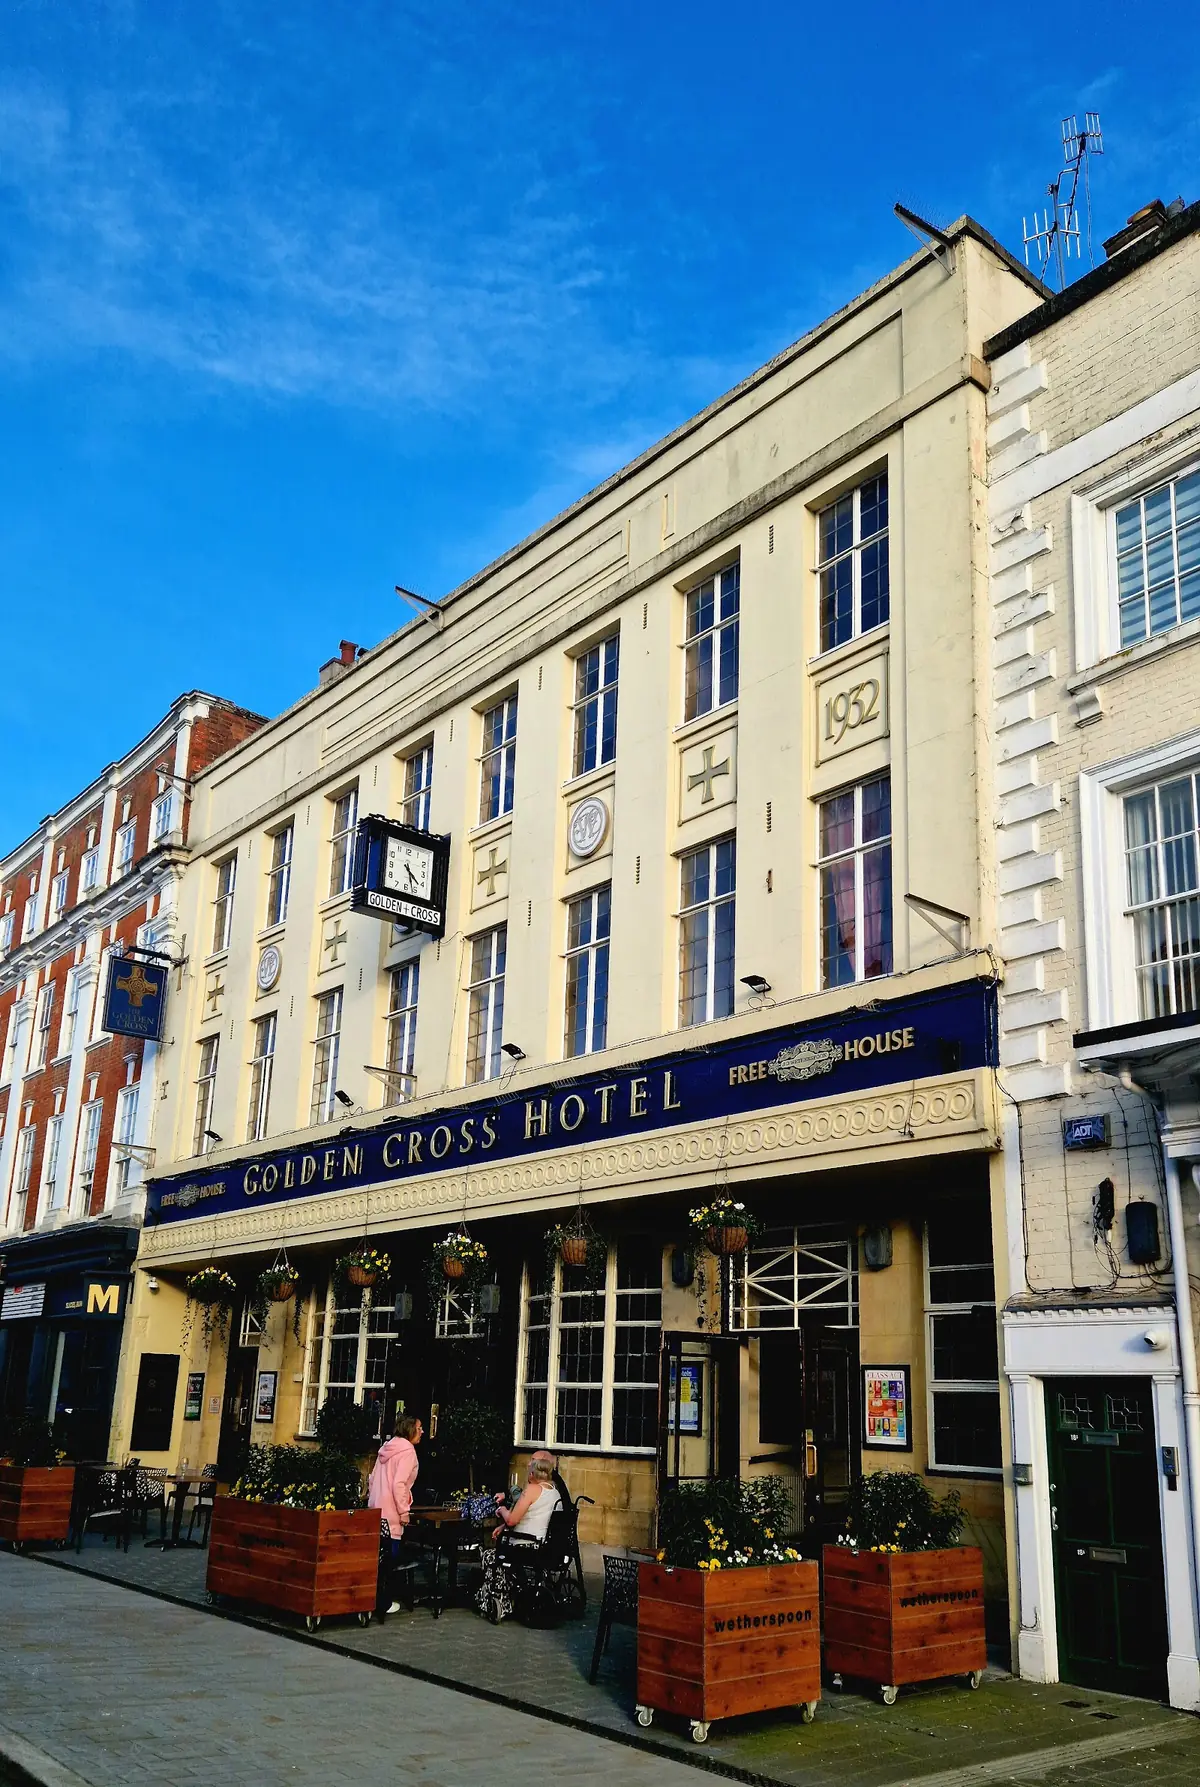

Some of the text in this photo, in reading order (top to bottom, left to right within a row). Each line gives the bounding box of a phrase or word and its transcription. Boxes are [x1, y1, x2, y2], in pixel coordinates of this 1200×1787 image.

[824, 678, 880, 745] 1932
[369, 893, 439, 924] GOLDEN CROSS
[729, 1027, 915, 1086] FREE HOUSE
[243, 1070, 681, 1195] GOLDEN CROSS HOTEL
[1074, 1124, 1092, 1137] ADT
[87, 1284, 120, 1314] M
[901, 1588, 978, 1608] wetherspoon
[714, 1607, 812, 1633] wetherspoon
